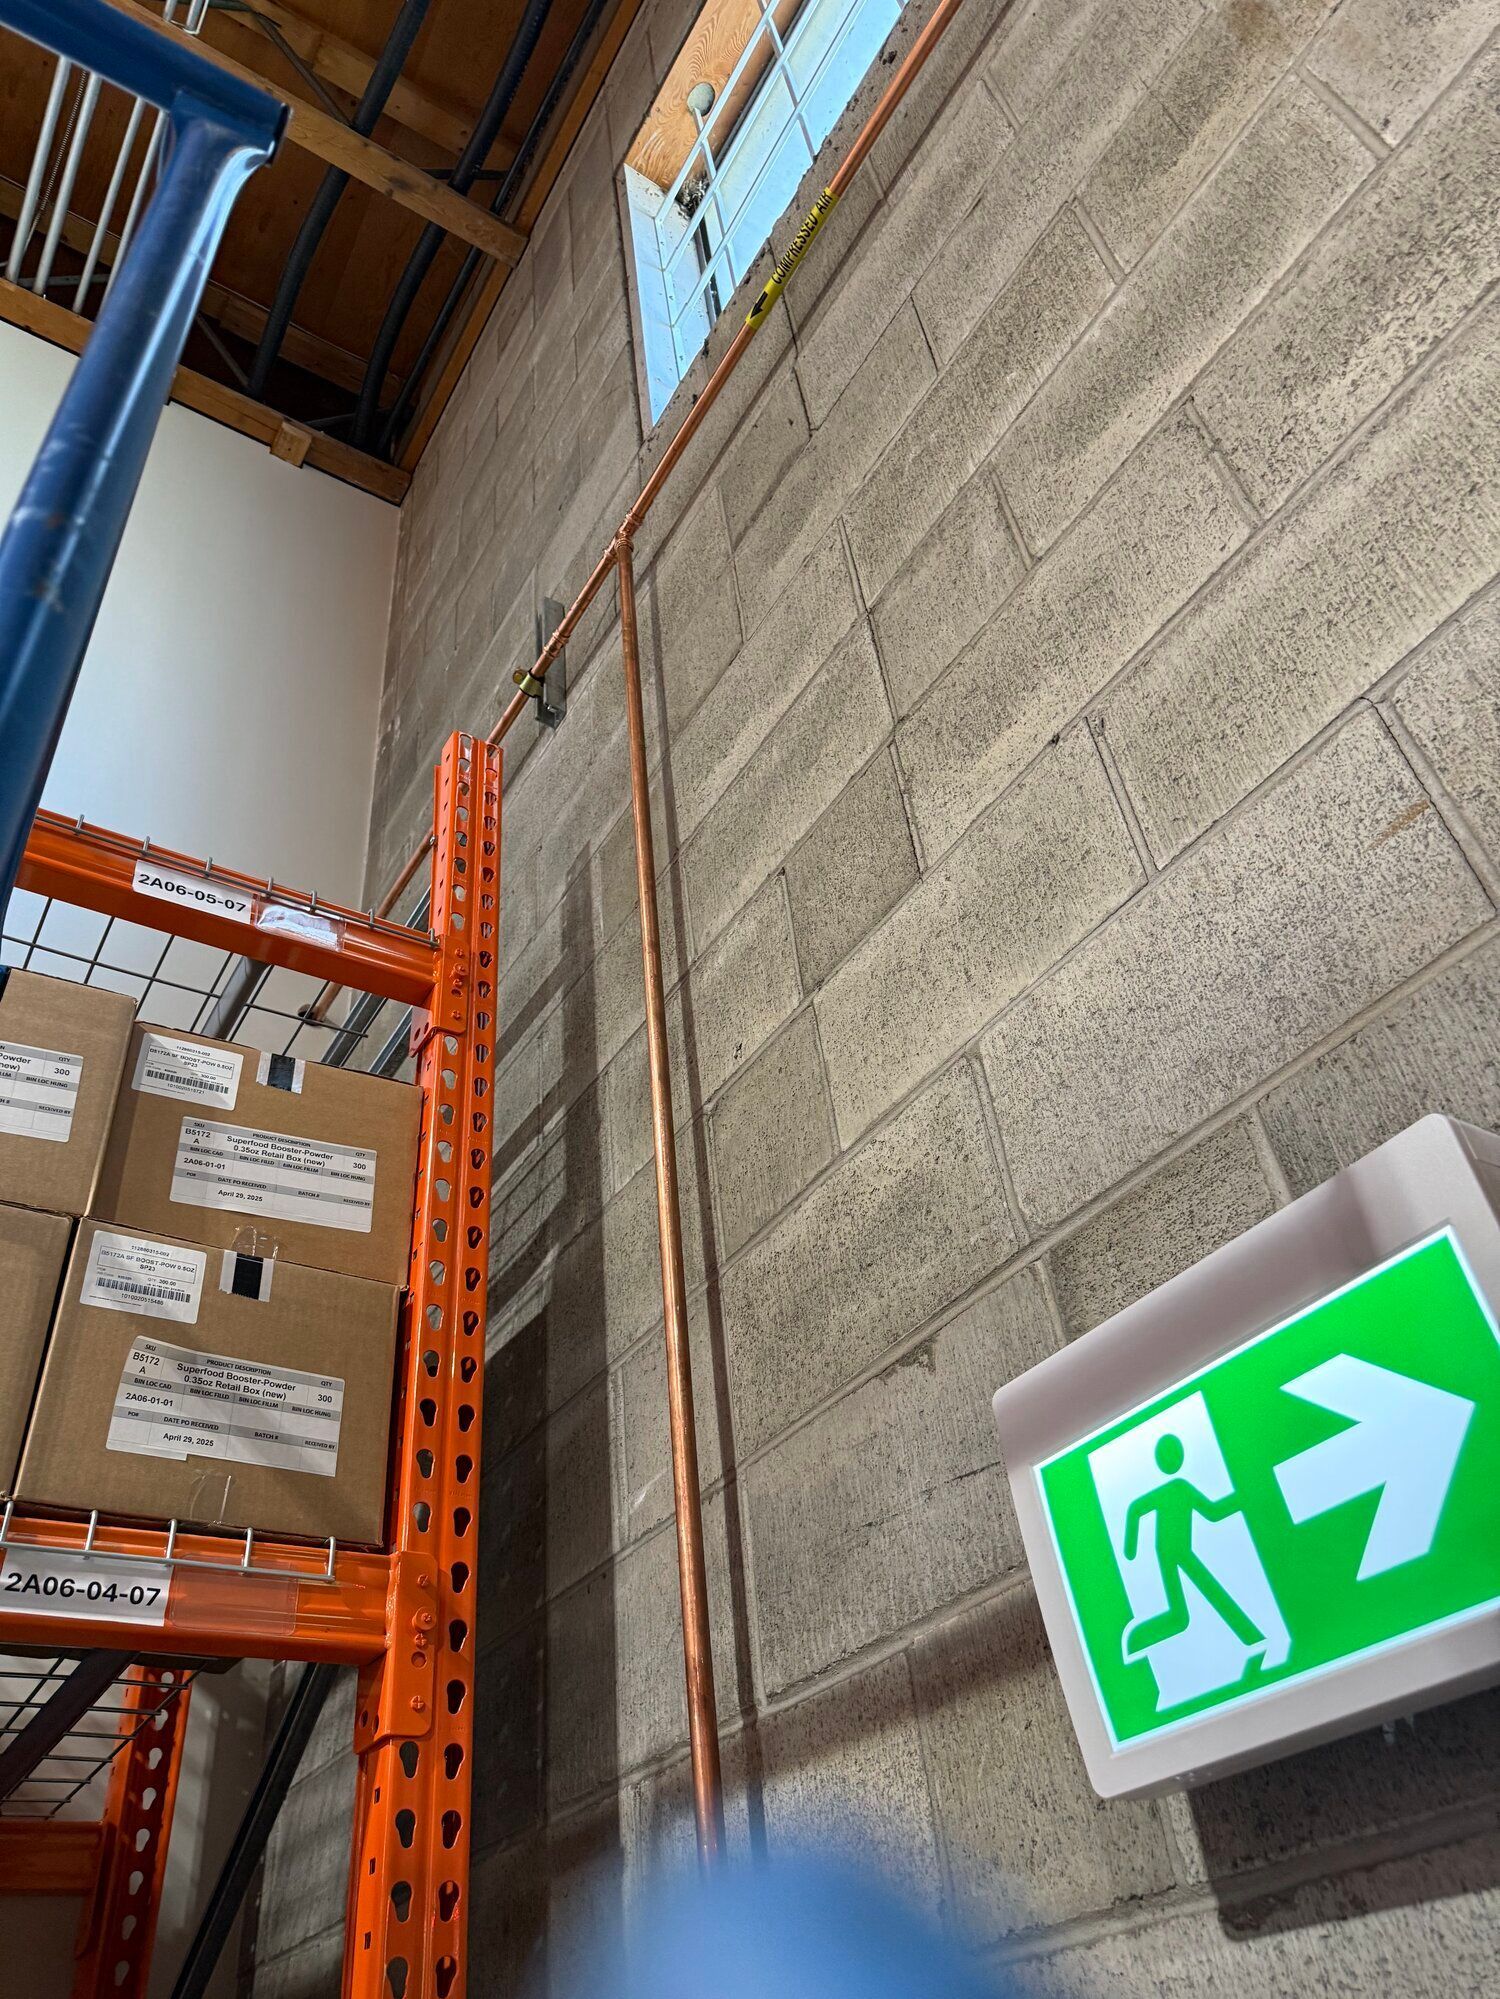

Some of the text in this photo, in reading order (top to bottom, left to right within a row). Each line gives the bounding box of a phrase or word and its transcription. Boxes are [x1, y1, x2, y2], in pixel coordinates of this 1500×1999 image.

[772, 191, 833, 284] COMPRESSED AIR
[138, 873, 246, 912] 2A06-05-07
[54, 1068, 70, 1076] 300
[185, 1128, 211, 1138] B5172
[253, 1133, 311, 1148] PRODUCT DESCRIPTION
[227, 1136, 333, 1160] Superfood Booster-Powder
[234, 1145, 325, 1167] 0.35oz Retail Box (new)
[184, 1158, 226, 1170] 2A06-01-01
[353, 1162, 366, 1170] 300
[242, 1181, 267, 1189] RECEIVED
[218, 1190, 234, 1198] April
[136, 1256, 176, 1269] BOOST-POW
[133, 1352, 160, 1366] B5172
[139, 1366, 146, 1374] A
[207, 1359, 271, 1376] PRODUCT DESCRIPTION
[177, 1363, 296, 1391] Superfood Booster-Powder
[184, 1375, 286, 1401] 0.35oz Retail Box (new)
[125, 1392, 173, 1407] 2A06-01-01
[214, 1392, 229, 1400] FILLD
[318, 1394, 332, 1403] 300
[191, 1421, 219, 1430] RECEIVED
[163, 1433, 214, 1447] April 29, 2025
[305, 1440, 327, 1448] RECEIVED
[4, 1572, 161, 1606] 2A06-04-07
